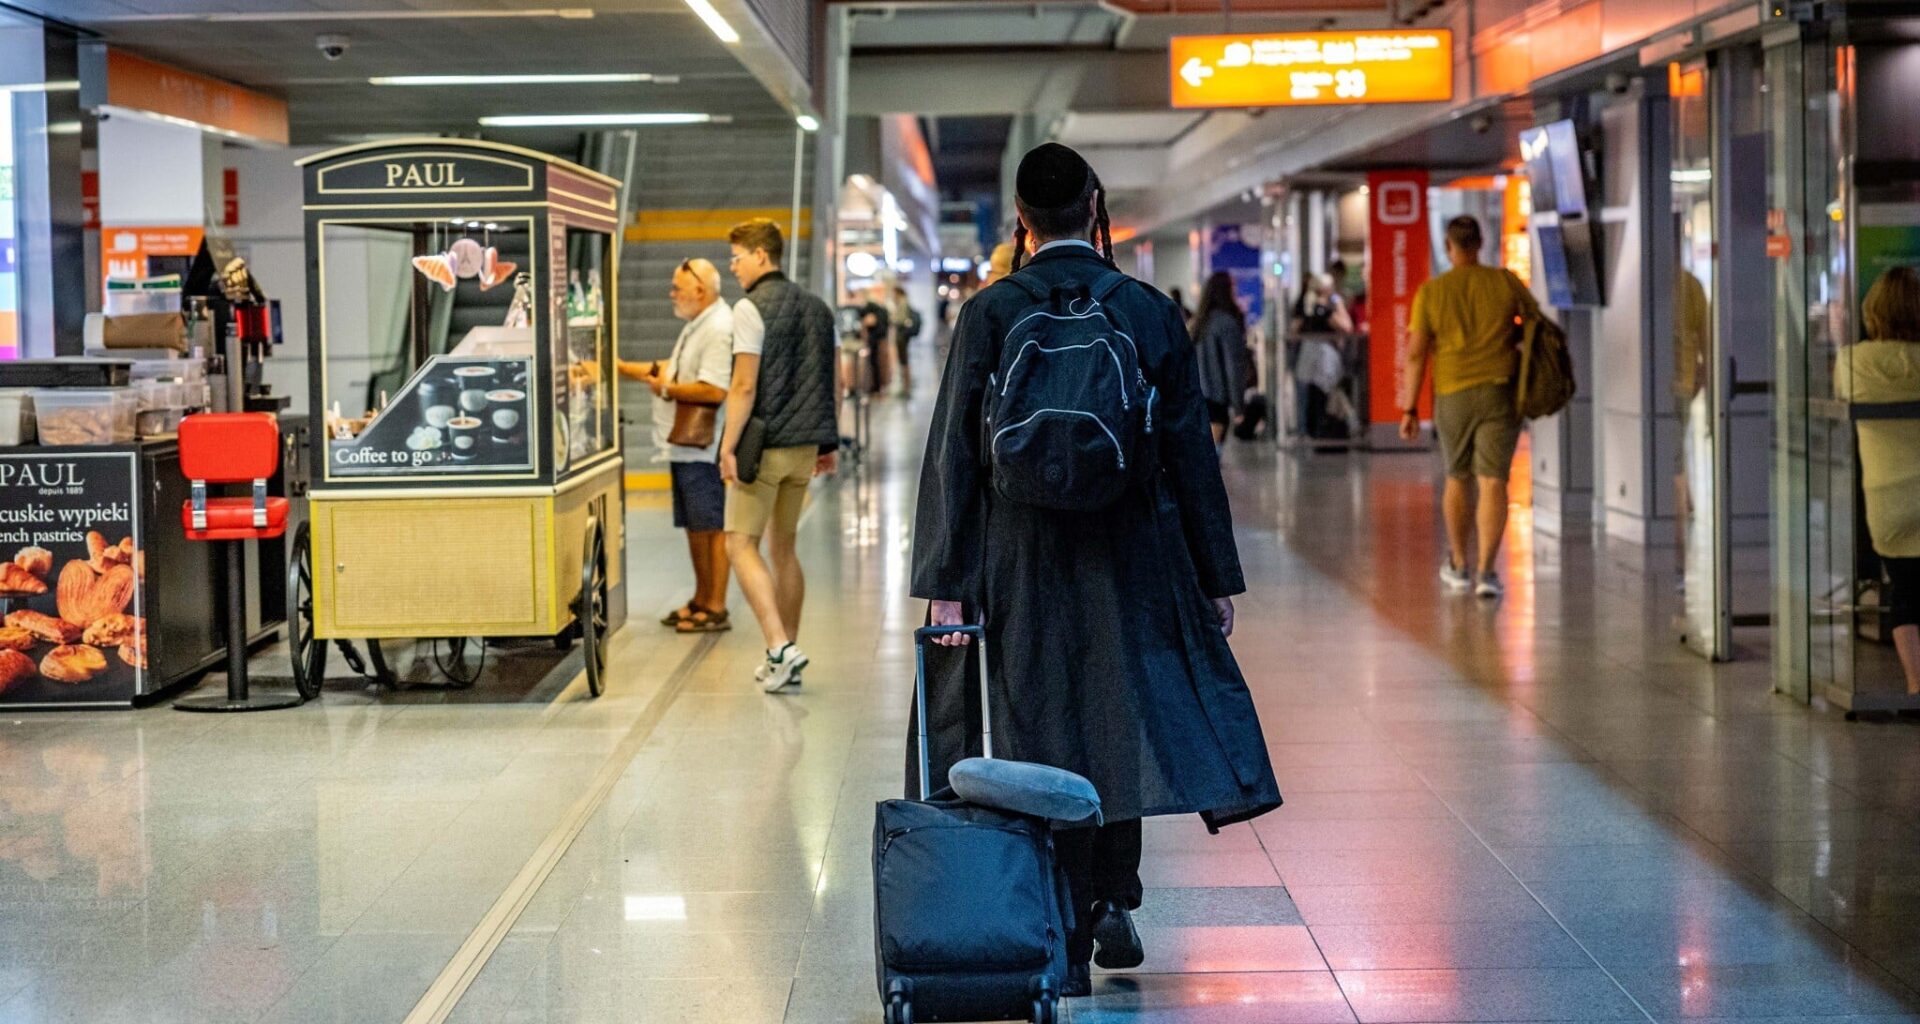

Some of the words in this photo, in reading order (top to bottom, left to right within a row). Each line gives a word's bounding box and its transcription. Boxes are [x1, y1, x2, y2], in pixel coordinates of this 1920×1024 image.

[385, 163, 464, 186] PAUL
[335, 446, 388, 464] Coffee
[391, 450, 408, 462] to
[412, 450, 432, 466] go
[0, 463, 85, 486] PAUL
[38, 487, 64, 496] depuis
[66, 486, 84, 494] 1889
[0, 503, 54, 522] cuskie
[58, 502, 129, 527] wypieki
[33, 526, 84, 546] pastries
